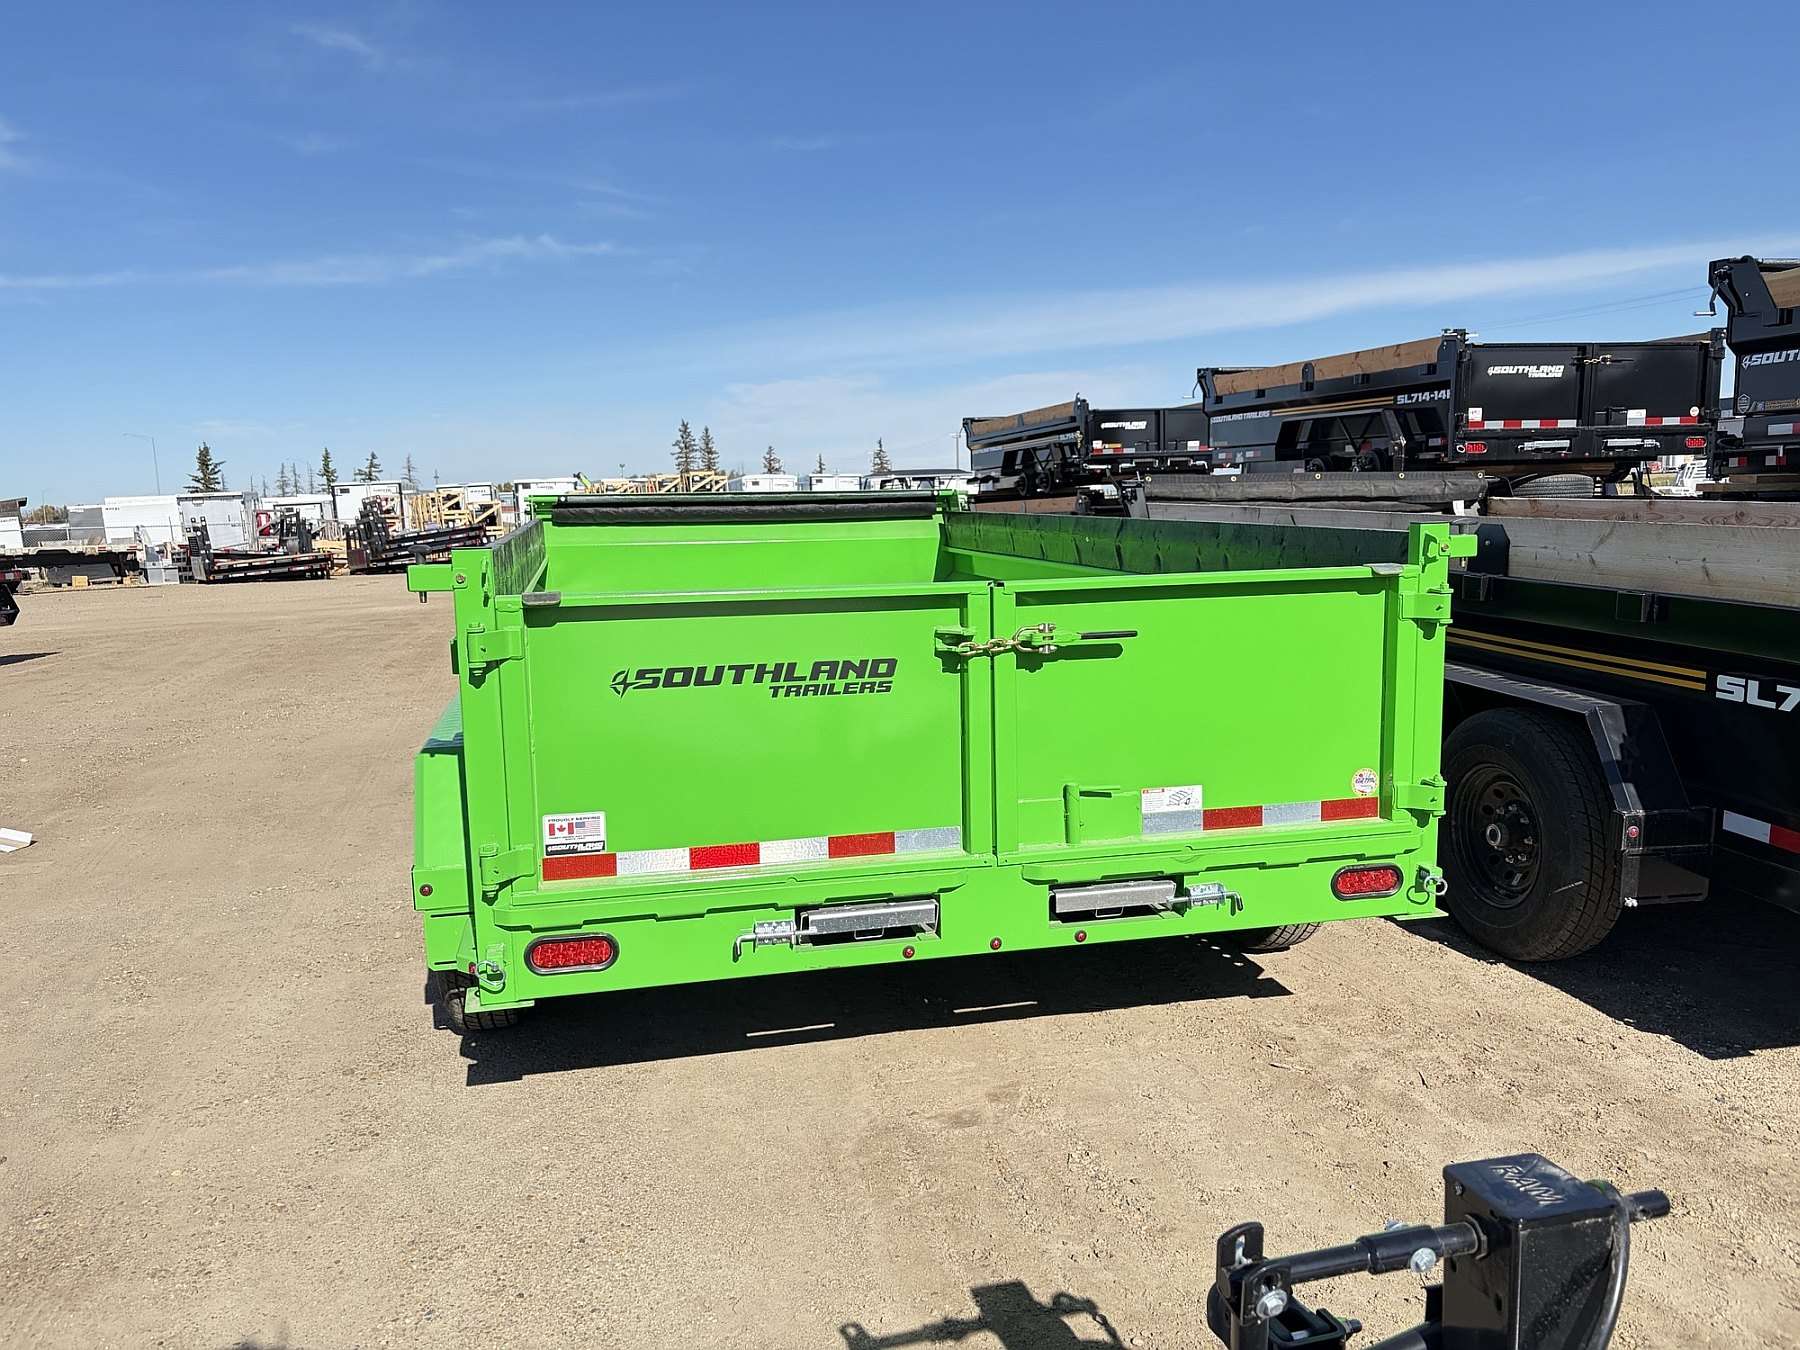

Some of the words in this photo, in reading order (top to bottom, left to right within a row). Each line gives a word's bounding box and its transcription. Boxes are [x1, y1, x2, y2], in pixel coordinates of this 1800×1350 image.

[1750, 349, 1800, 366] SOUT
[1493, 365, 1565, 374] SOUTHLAND
[632, 657, 898, 690] SOUTHLAND
[769, 680, 894, 699] TRAILERS
[1716, 674, 1800, 712] SL7
